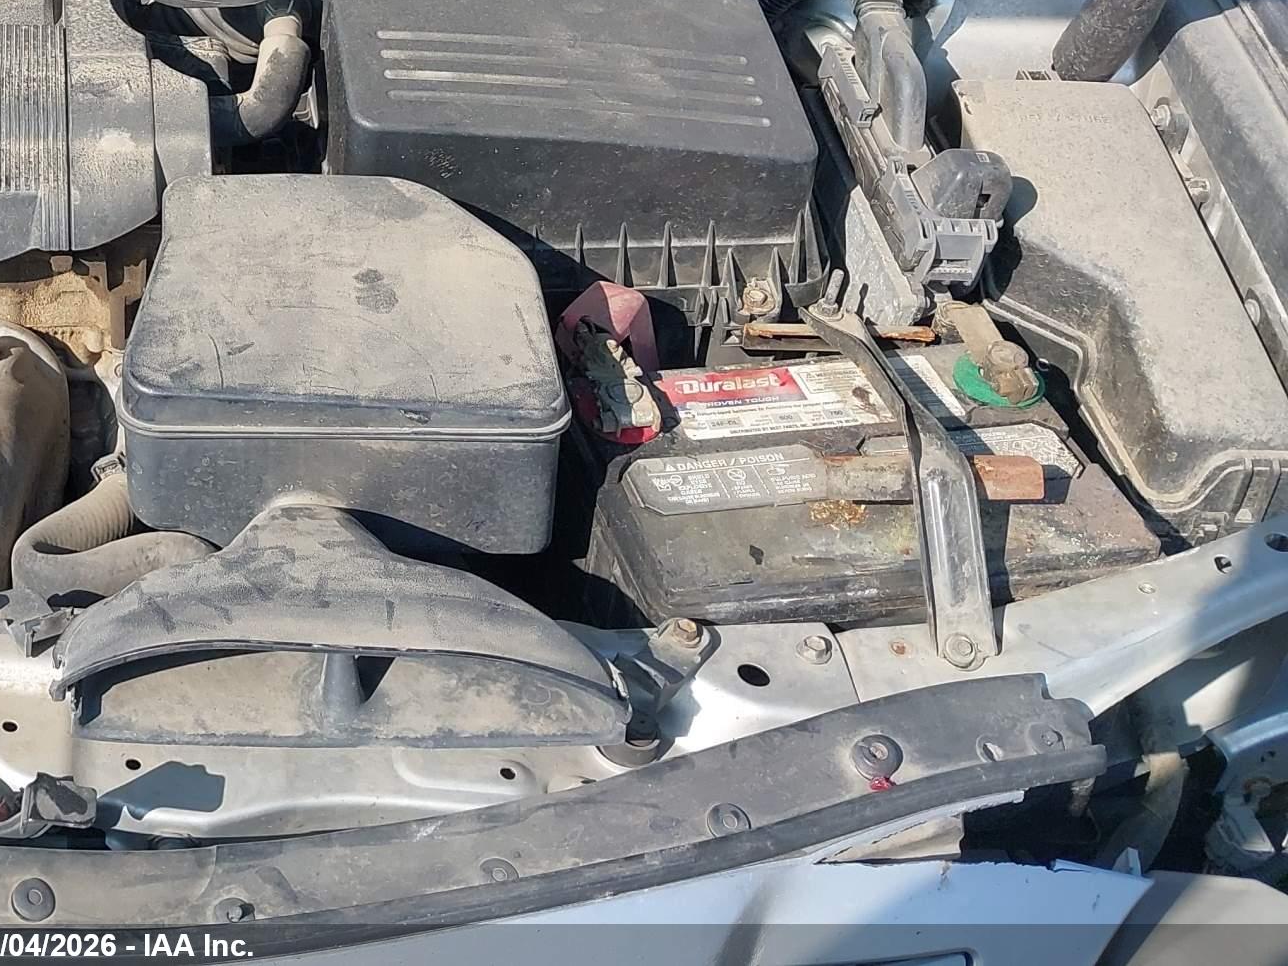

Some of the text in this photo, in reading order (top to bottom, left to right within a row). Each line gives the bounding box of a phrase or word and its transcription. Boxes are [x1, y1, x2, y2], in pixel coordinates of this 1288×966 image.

[674, 372, 781, 395] Duralast
[700, 399, 742, 409] ROVEN
[745, 395, 780, 405] TOUGH
[677, 458, 727, 472] DANGER
[739, 452, 785, 465] POISON
